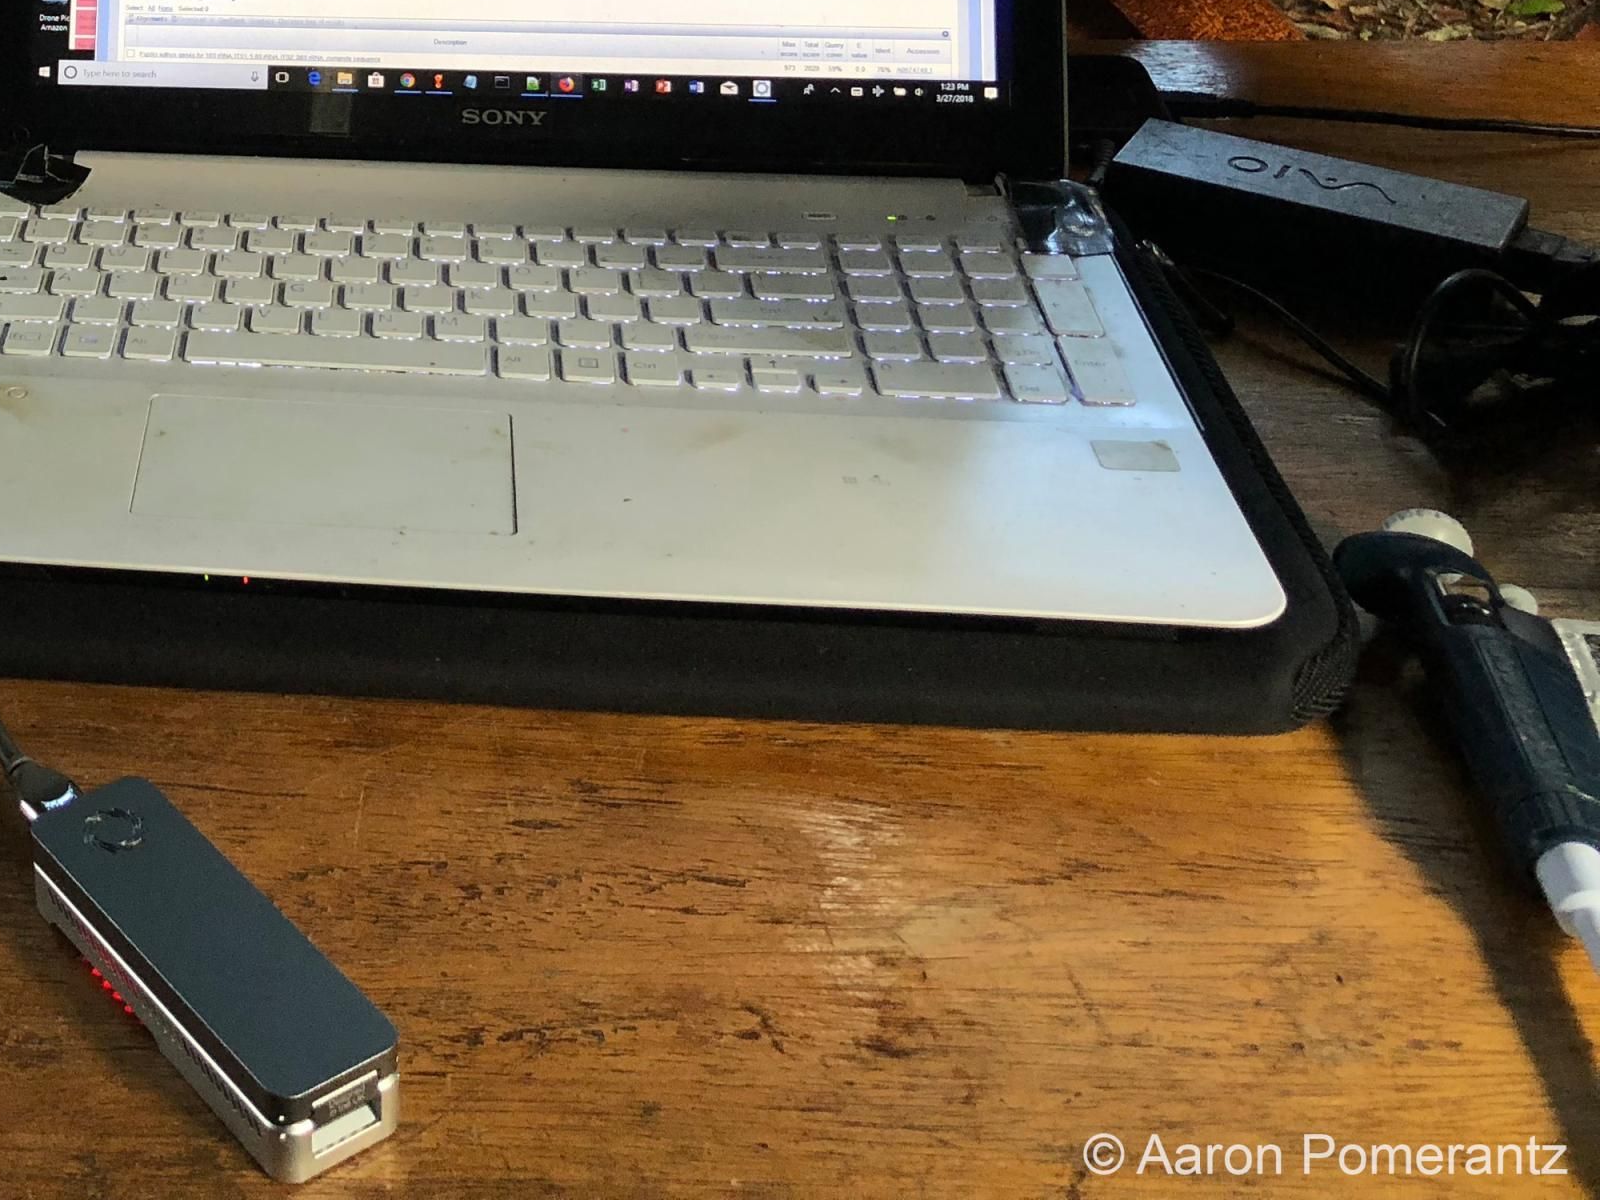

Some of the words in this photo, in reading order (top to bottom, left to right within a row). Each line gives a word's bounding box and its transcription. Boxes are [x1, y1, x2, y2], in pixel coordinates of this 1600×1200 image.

[38, 13, 60, 22] Drone
[40, 23, 68, 31] Amazon
[433, 38, 468, 47] Description
[82, 68, 101, 78] Type
[102, 69, 120, 77] here
[121, 70, 130, 78] to
[132, 70, 157, 79] search
[956, 82, 970, 91] PM
[461, 108, 547, 126] SONY
